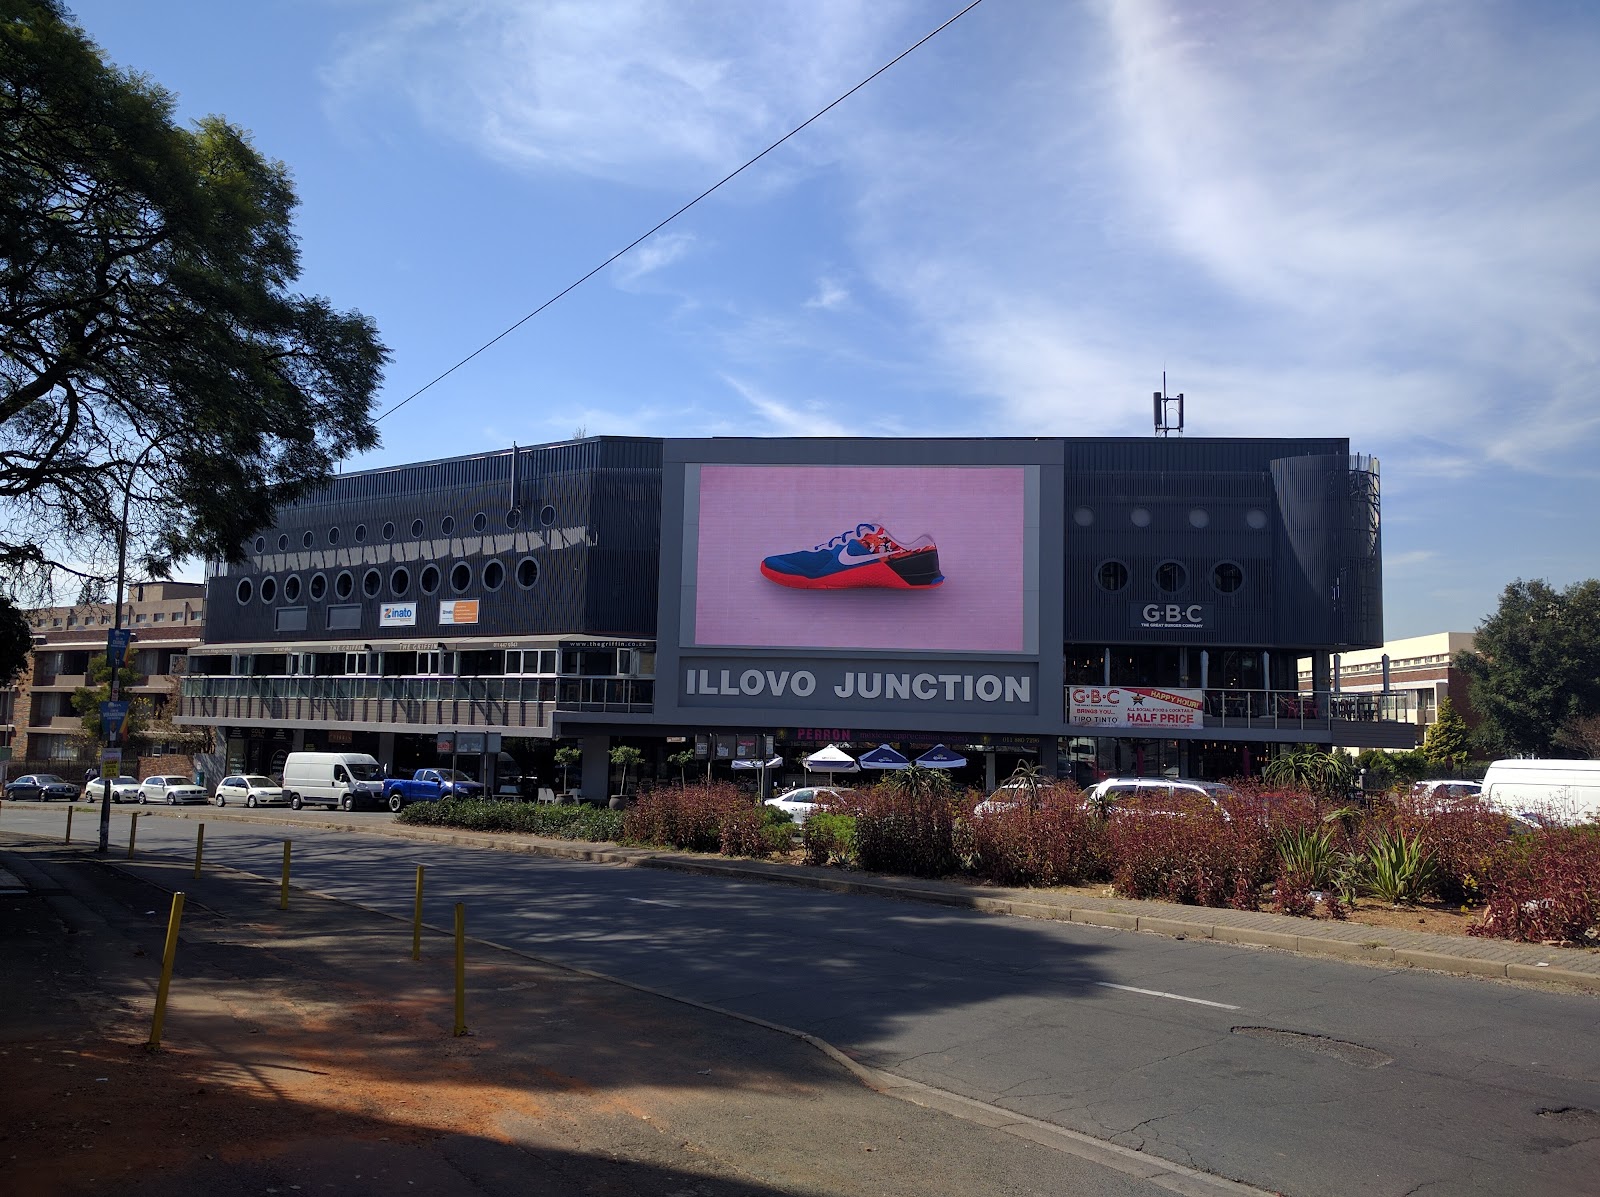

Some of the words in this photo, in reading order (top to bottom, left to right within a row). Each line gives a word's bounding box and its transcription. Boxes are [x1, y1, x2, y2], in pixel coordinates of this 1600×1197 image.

[412, 642, 438, 650] GRIFFIN
[686, 669, 816, 697] ILLOVO
[834, 672, 1031, 702] JUNCTION
[1150, 690, 1176, 702] HAPPY
[1176, 697, 1199, 708] HOUR!
[1127, 713, 1157, 723] HALF
[1160, 713, 1195, 723] PRICE
[797, 728, 851, 741] PERRON
[893, 733, 941, 742] appreciation
[942, 734, 969, 743] society
